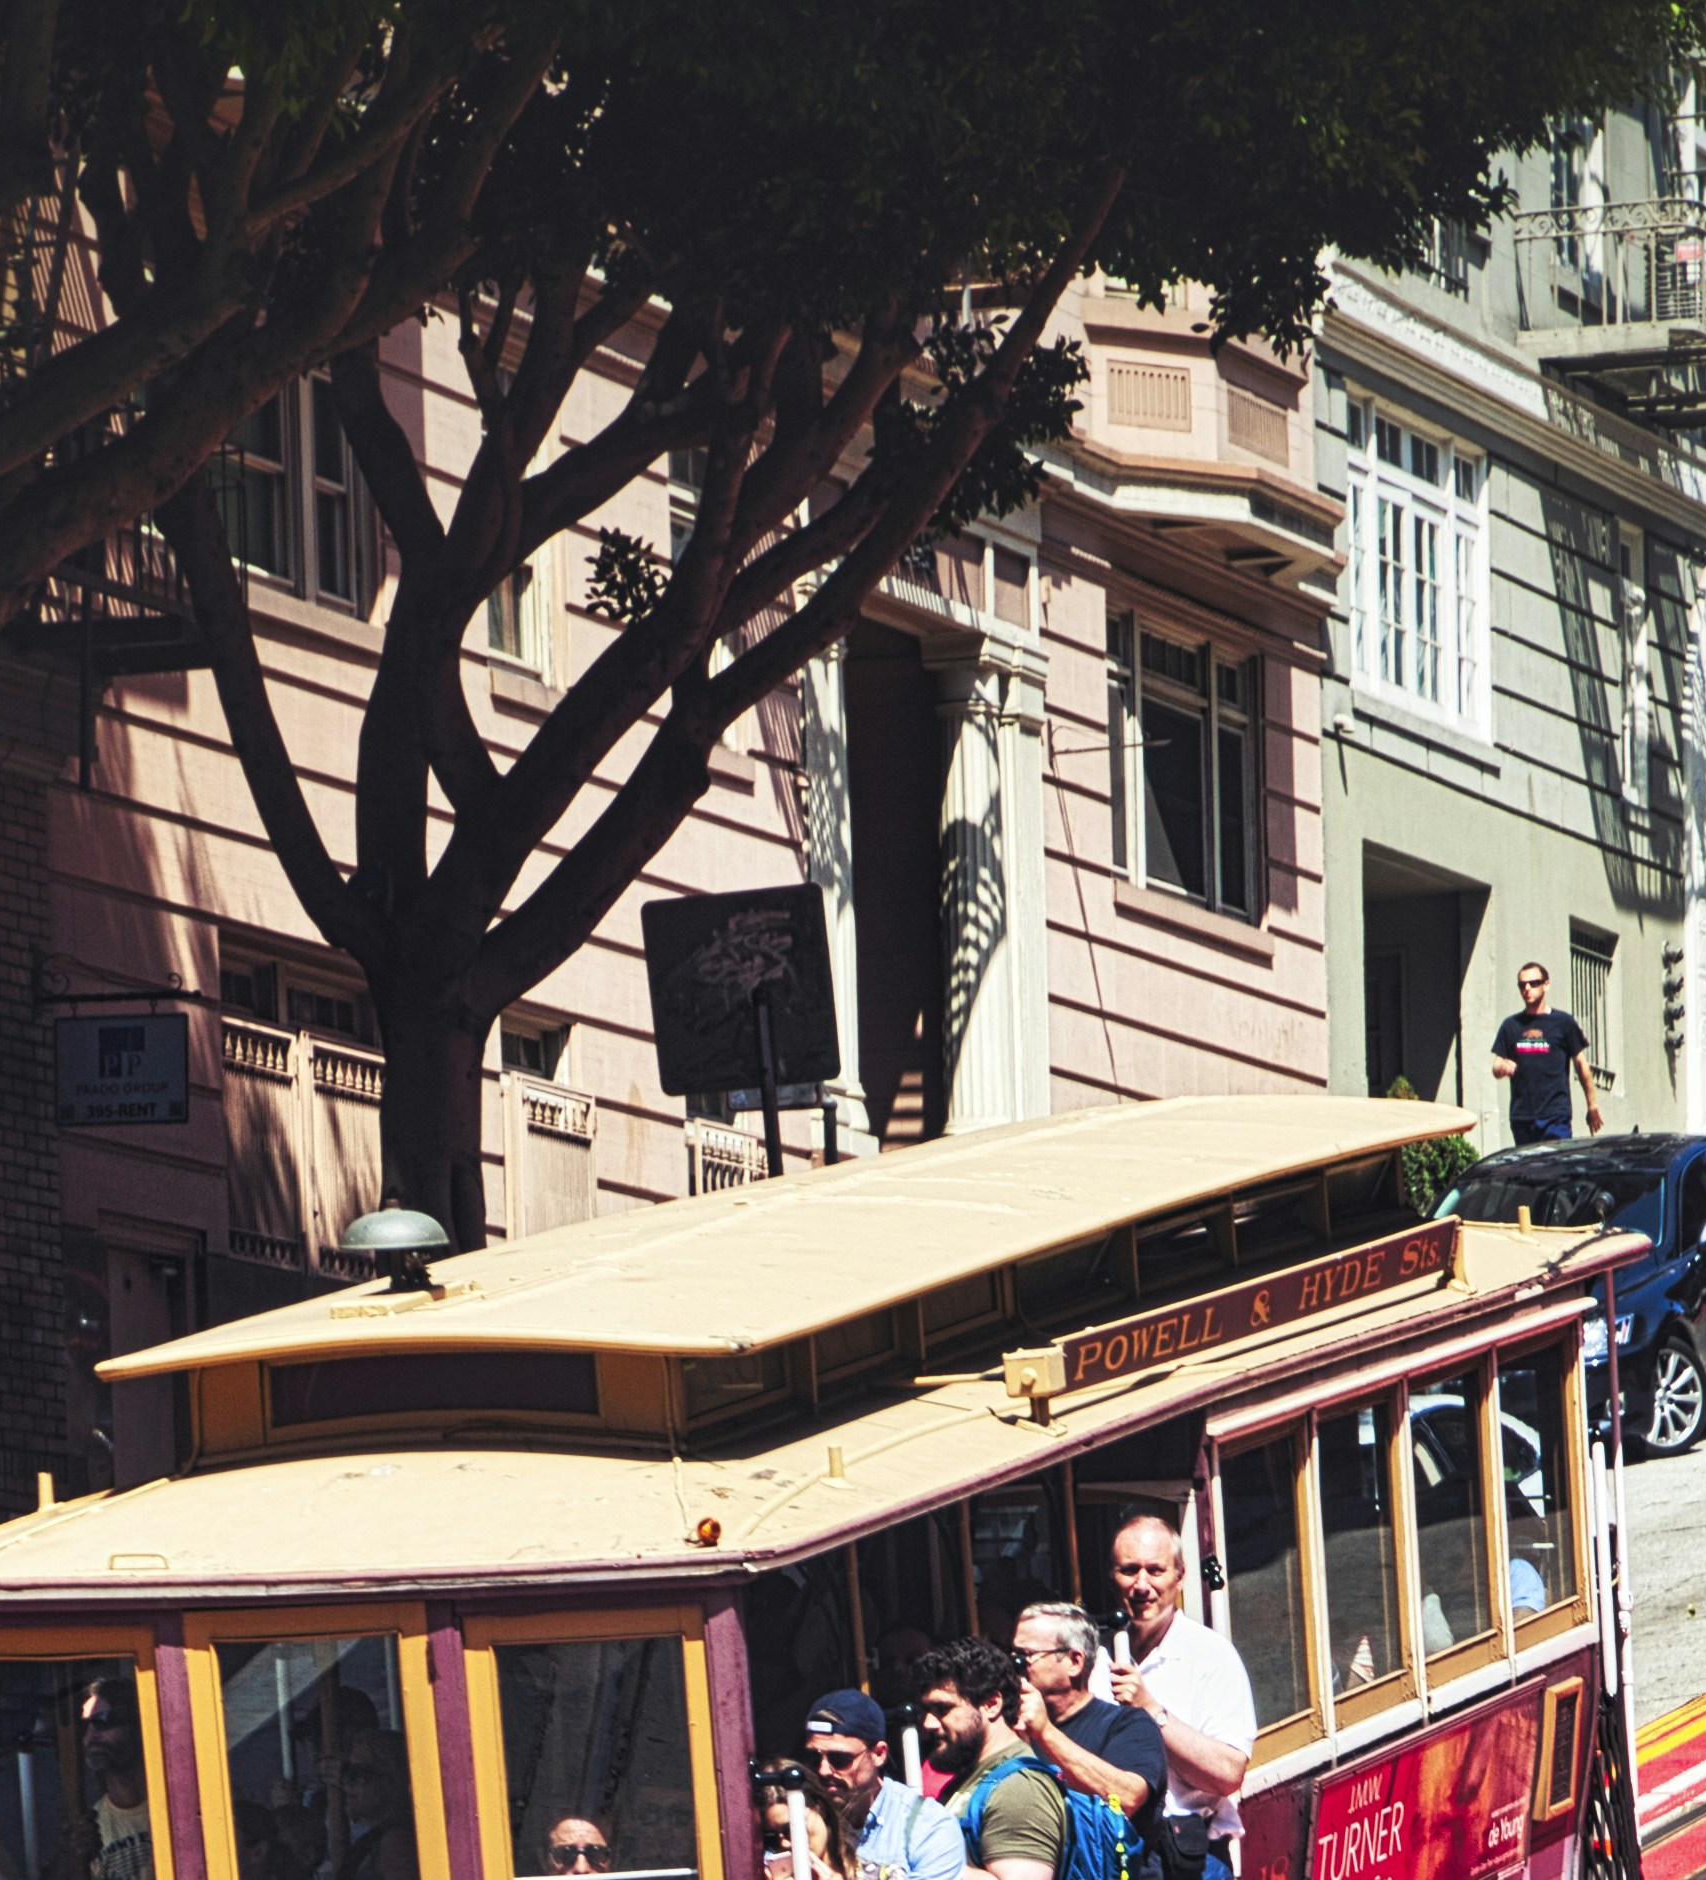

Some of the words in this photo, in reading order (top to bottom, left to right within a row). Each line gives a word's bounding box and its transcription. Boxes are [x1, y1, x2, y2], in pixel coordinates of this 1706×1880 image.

[123, 1081, 169, 1095] GROUP
[86, 1102, 157, 1118] 395-RENT
[1073, 1305, 1225, 1382] POWELL
[1249, 1289, 1271, 1328] &
[1298, 1250, 1387, 1313] HYDE
[1399, 1234, 1443, 1277] Sts.
[1487, 1821, 1500, 1848] de
[1500, 1814, 1525, 1843] Young
